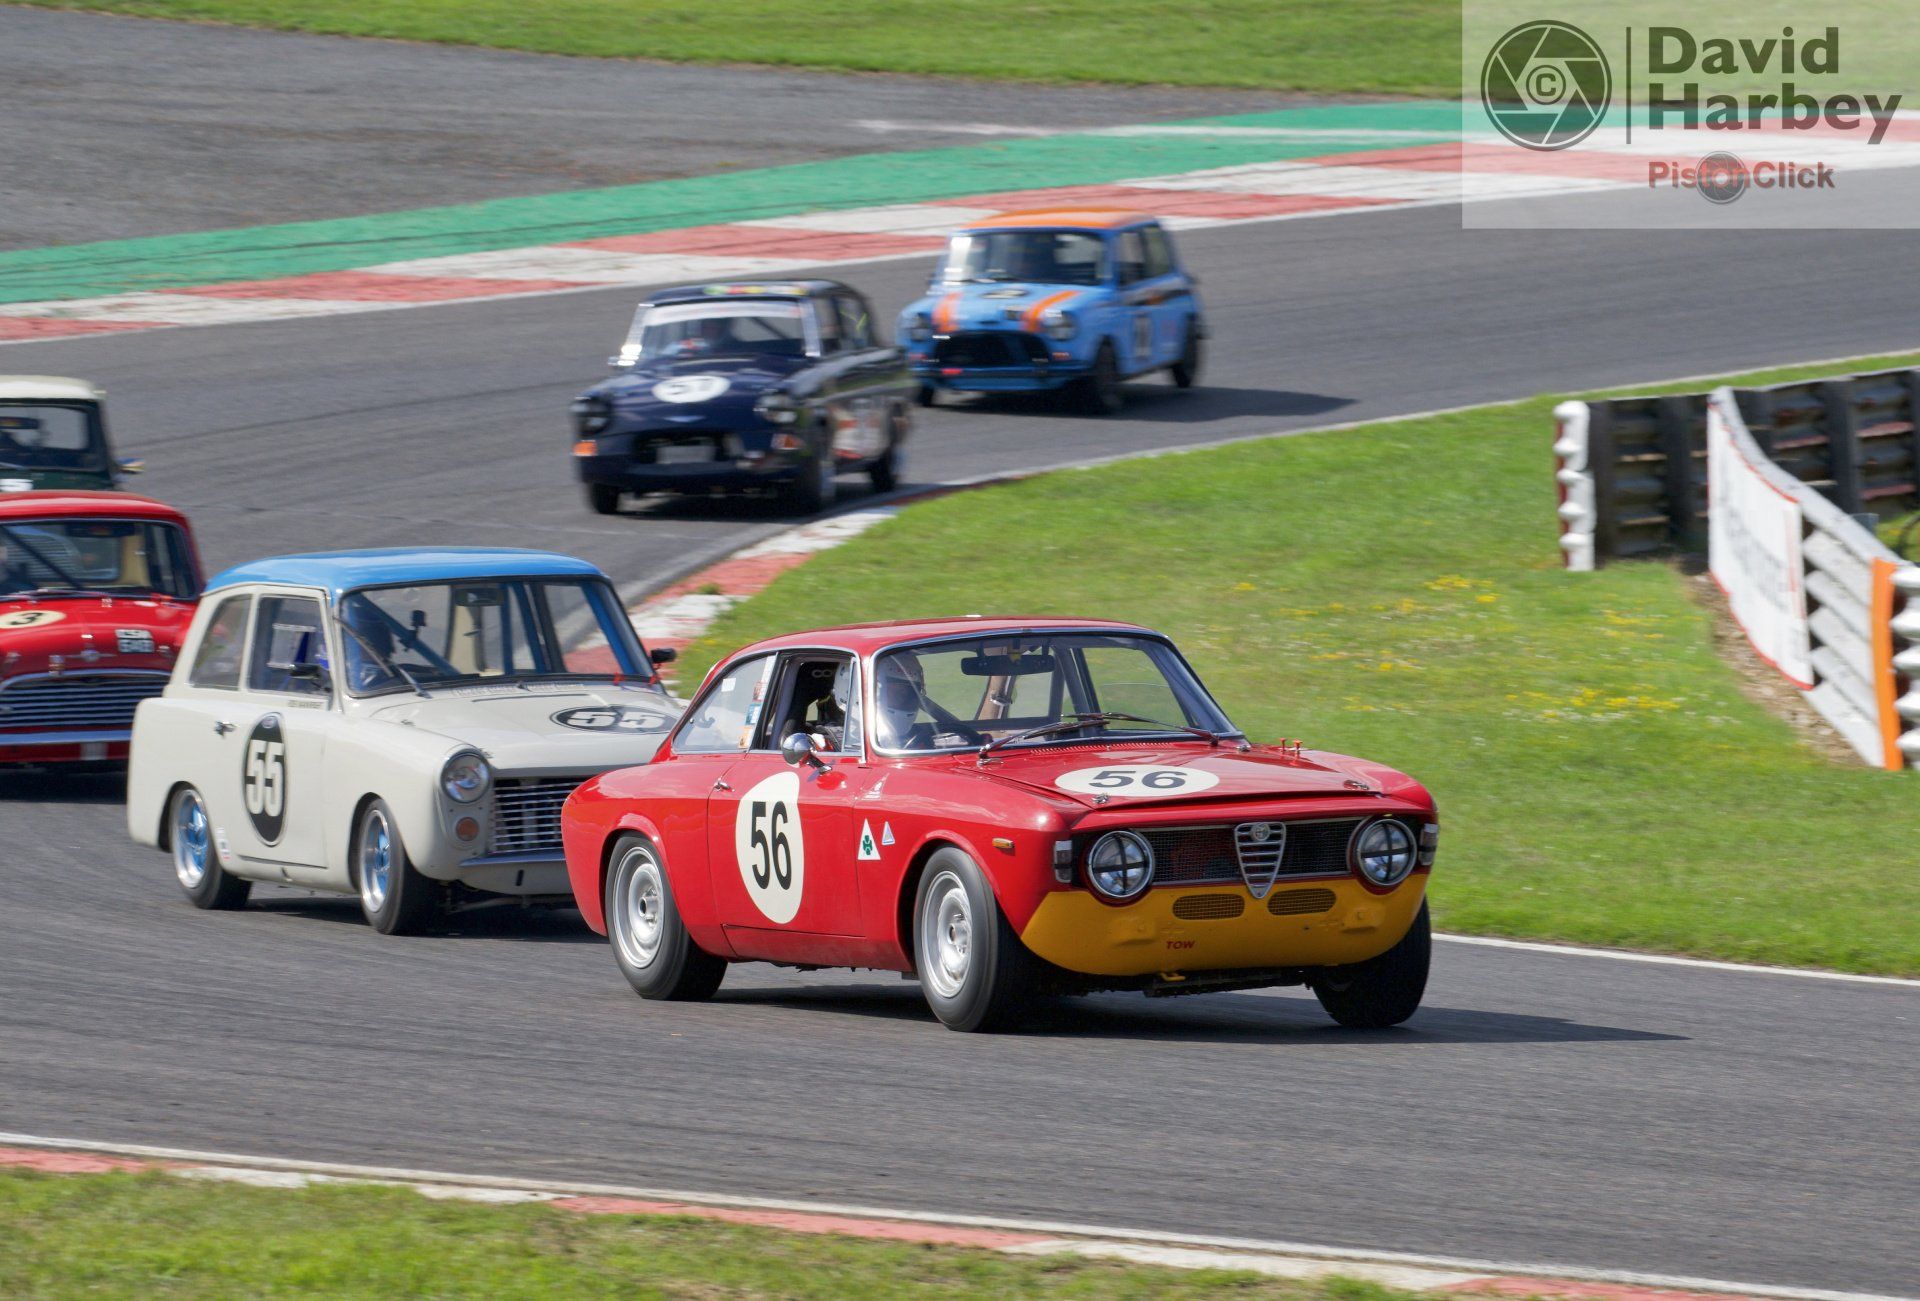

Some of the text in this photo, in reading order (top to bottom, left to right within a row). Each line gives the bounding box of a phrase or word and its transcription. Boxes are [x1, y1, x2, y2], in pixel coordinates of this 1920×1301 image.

[9, 612, 45, 626] 3
[566, 711, 667, 729] 55
[245, 739, 285, 817] 55
[1088, 770, 1188, 789] 56
[751, 800, 793, 891] 56
[1165, 940, 1197, 950] TOW
